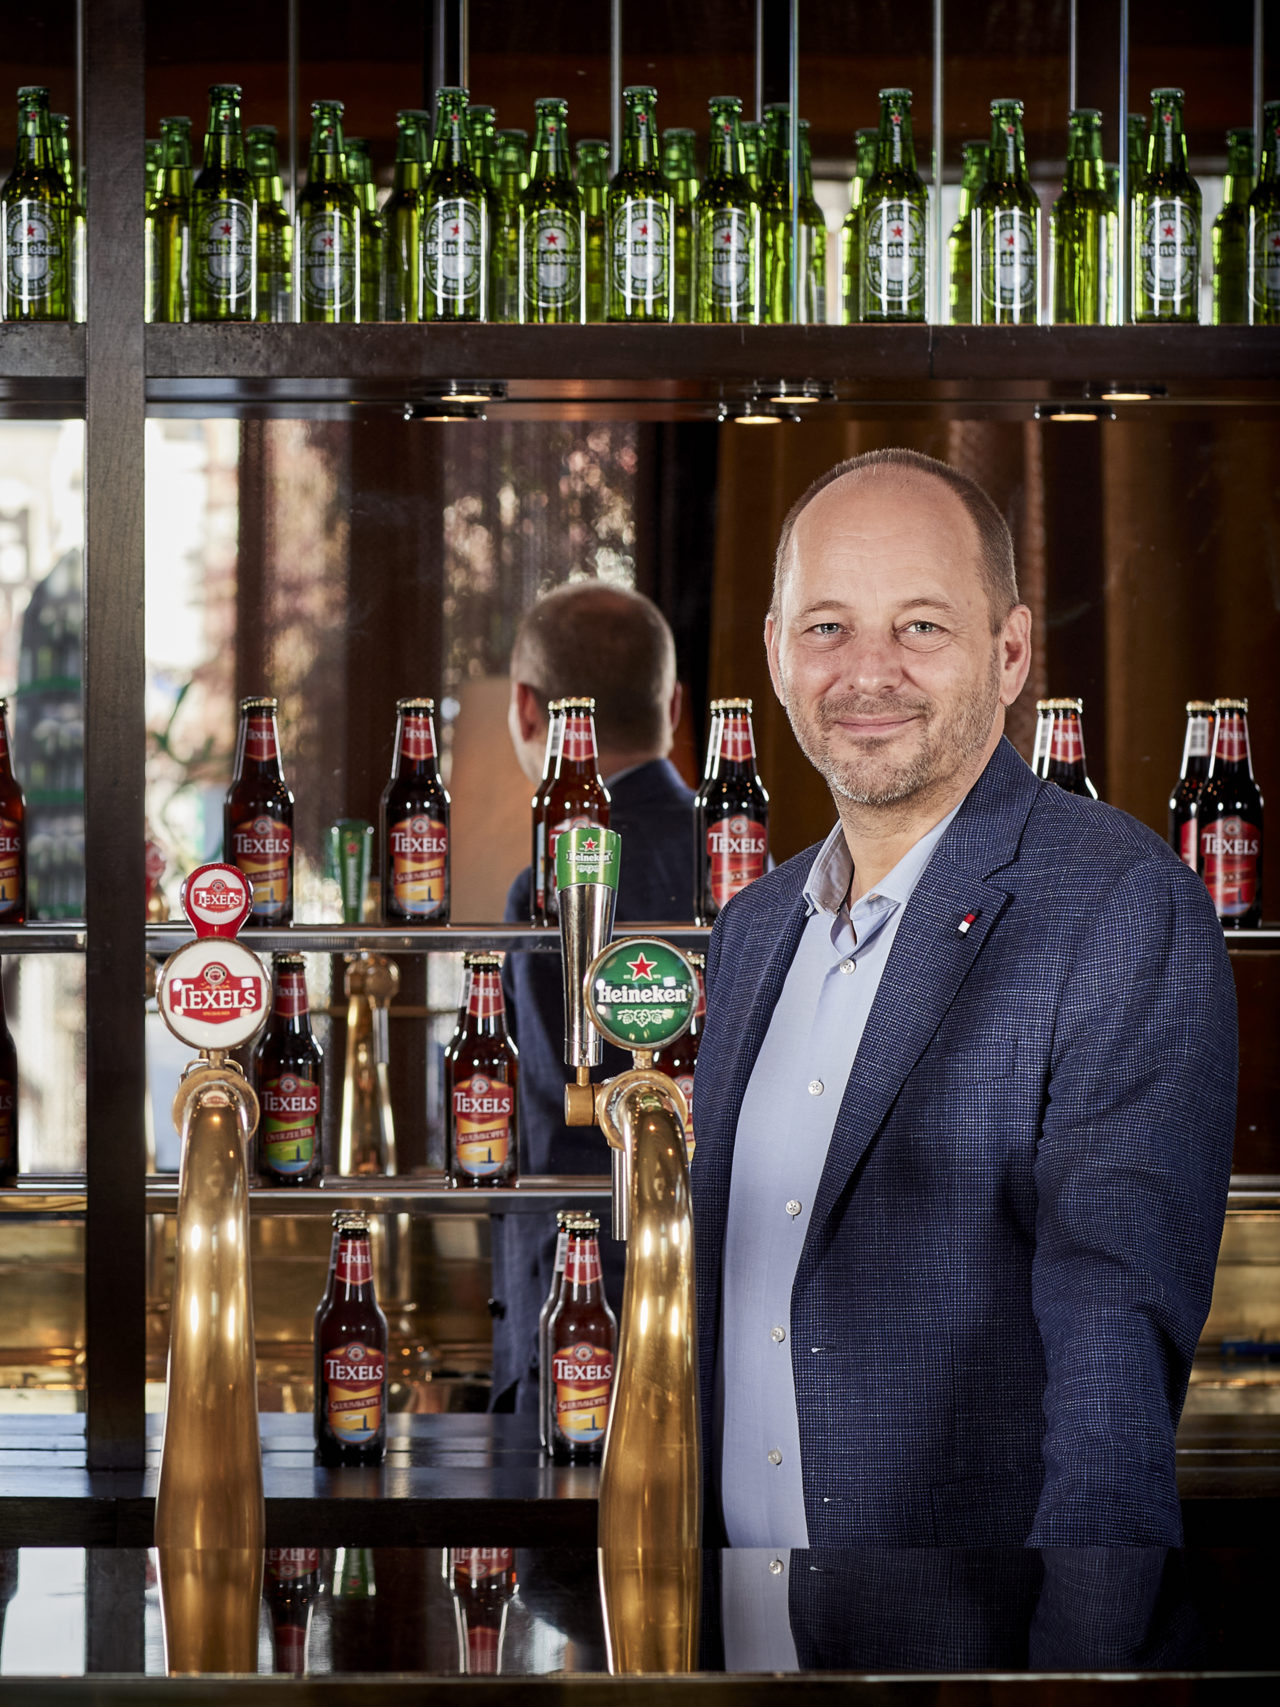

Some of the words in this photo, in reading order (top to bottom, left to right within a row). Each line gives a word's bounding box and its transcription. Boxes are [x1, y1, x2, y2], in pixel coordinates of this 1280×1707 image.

[426, 241, 482, 256] Hineken
[867, 243, 925, 257] Heneen
[1140, 243, 1197, 257] Heneen
[233, 833, 290, 854] TEXELS
[391, 832, 447, 853] TEXELS
[708, 832, 765, 854] TEXELS
[1202, 833, 1258, 855] TEXELS
[195, 890, 242, 905] TEXELS
[180, 984, 257, 1009] TEXELS
[597, 985, 687, 1003] Heineken
[261, 1091, 317, 1112] TEXELS
[454, 1092, 510, 1112] TEXELS
[326, 1359, 383, 1380] TEXELS
[553, 1359, 612, 1380] TEXELS
